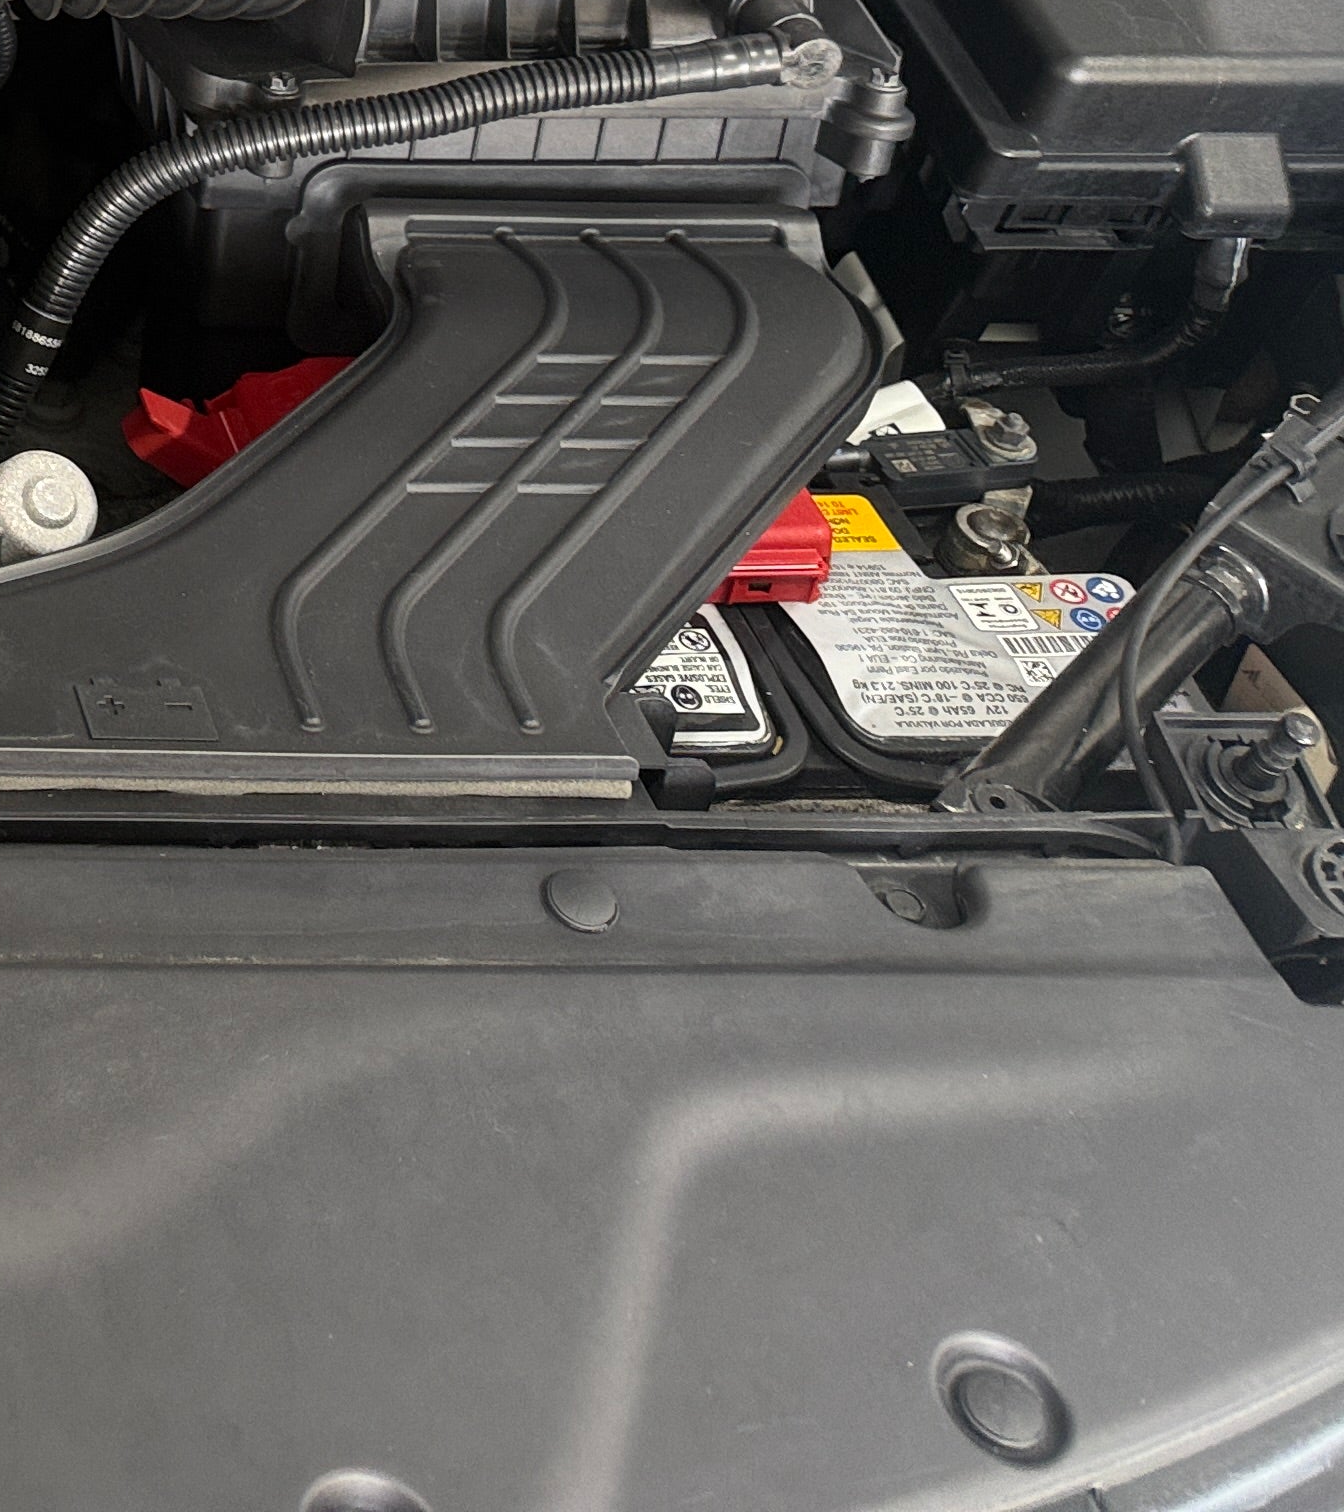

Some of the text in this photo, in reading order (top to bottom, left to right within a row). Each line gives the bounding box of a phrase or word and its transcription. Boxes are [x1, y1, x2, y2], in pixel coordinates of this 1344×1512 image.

[920, 665, 937, 674] por
[645, 673, 727, 683] EXPLOSIVE GASES
[852, 679, 869, 691] kg
[936, 681, 958, 690] 100
[704, 695, 736, 705] SHIELD
[976, 693, 1004, 703] CCA
[1008, 693, 1028, 702] 650
[942, 705, 975, 716] 65Ah
[986, 705, 1009, 715] 12V
[941, 720, 962, 728] POR
